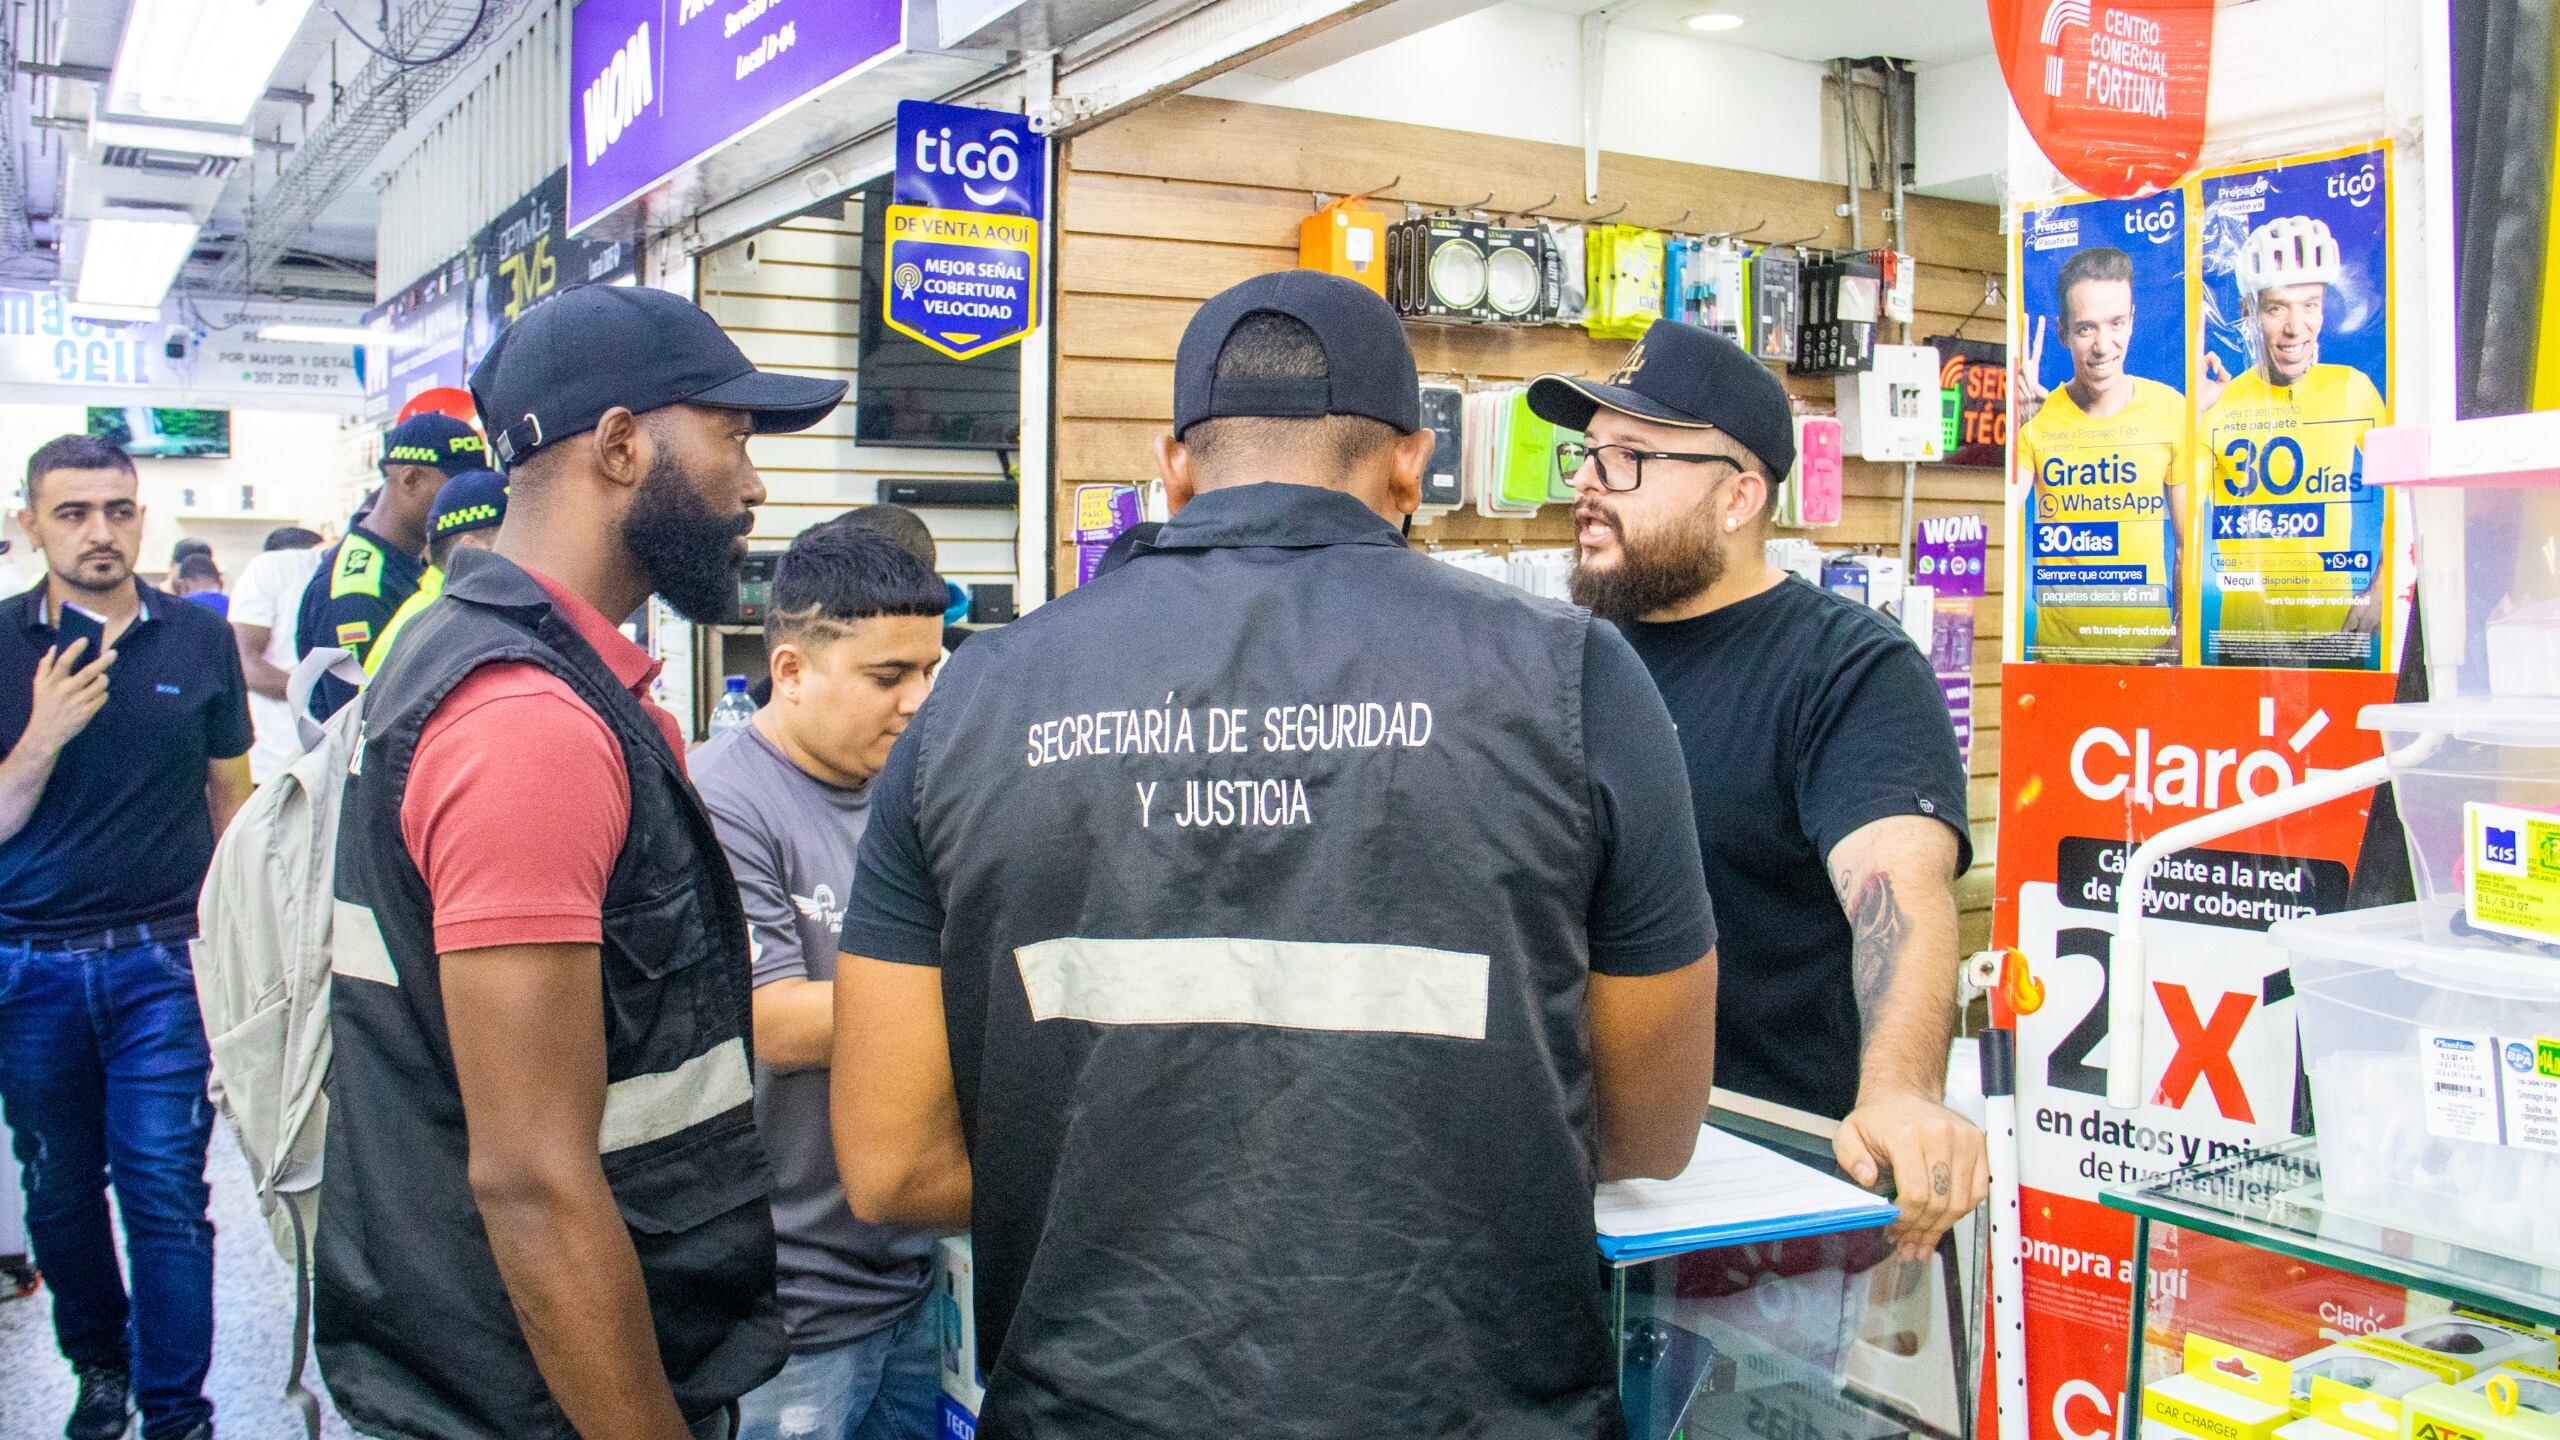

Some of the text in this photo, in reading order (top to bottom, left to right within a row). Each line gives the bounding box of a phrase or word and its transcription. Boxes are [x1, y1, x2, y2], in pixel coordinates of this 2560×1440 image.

[2105, 8, 2160, 46] CENTRO
[735, 35, 767, 81] Local
[2090, 32, 2168, 77] COMERCIAL
[583, 21, 654, 167] WOM
[2085, 60, 2167, 120] FORTUNA
[2218, 186, 2265, 199] Prepago
[2253, 202, 2263, 210] ya
[894, 216, 1029, 243] DE VENTA AQUÍ
[2035, 219, 2078, 233] Prepago
[2066, 236, 2076, 246] ya
[925, 259, 1025, 281] MEJOR SEÑAL
[924, 279, 1017, 300] COBERTURA
[924, 299, 1012, 319] VELOCIDAD
[219, 352, 245, 364] POR
[250, 352, 294, 366] MAYOR
[301, 353, 308, 365] Y
[2078, 428, 2116, 440] Prepago
[2223, 419, 2297, 432] este paquete
[2043, 454, 2137, 487] Gratis
[2223, 436, 2363, 497] 30 días
[2061, 492, 2164, 514] WhatsApp
[1923, 515, 1983, 545] WOM
[2037, 568, 2143, 584] Siempre que compres
[2262, 576, 2310, 587] disponible
[2042, 588, 2160, 604] paquetes desde $6 mil
[2284, 596, 2294, 605] tu
[2295, 596, 2325, 608] mejor
[2326, 595, 2342, 606] red
[2079, 625, 2177, 637] en tu mejor red móvil
[1946, 686, 1969, 700] WOM
[1028, 691, 1433, 767] SECRETARÍA DE SEGURIDAD
[2070, 725, 2294, 810] Claro
[1136, 778, 1312, 828] Y JUSTICIA
[2487, 844, 2516, 862] KIS
[2098, 849, 2303, 893] Cábiate a la red
[2083, 877, 2318, 921] de ayor cobertura
[2517, 901, 2529, 912] QT
[2507, 1050, 2533, 1067] BPA
[2517, 1089, 2543, 1102] Storage
[2036, 1107, 2073, 1137] en
[2080, 1109, 2174, 1156] datos
[2178, 1134, 2201, 1168] y
[2079, 1151, 2113, 1182] de
[2021, 1235, 2112, 1279] ompra
[2319, 1301, 2378, 1335] Claro
[2155, 1402, 2239, 1440] CAR CHARGER
